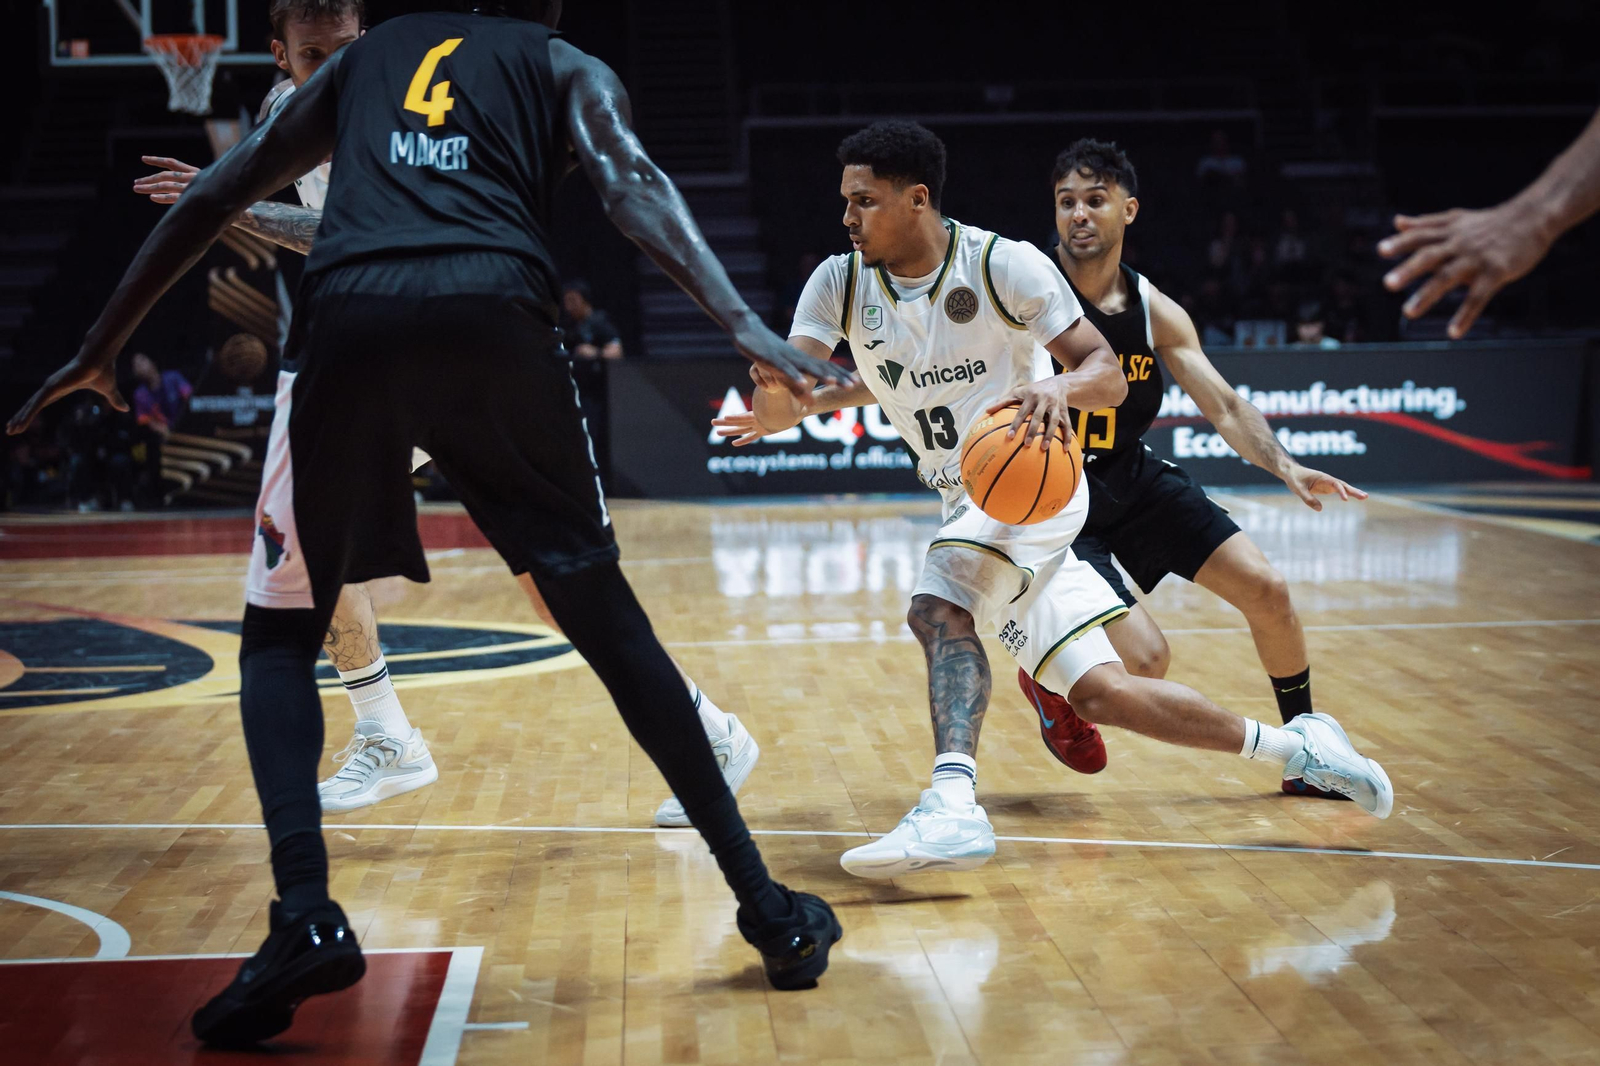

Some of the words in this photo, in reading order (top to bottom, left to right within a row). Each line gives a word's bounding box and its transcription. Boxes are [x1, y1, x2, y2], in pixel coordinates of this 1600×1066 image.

[403, 37, 464, 127] 4
[390, 131, 469, 170] MAKER
[1128, 355, 1153, 382] SC
[1235, 380, 1467, 420] anufacturing.
[913, 405, 959, 450] 13
[1173, 426, 1367, 465] Ecotems.
[707, 450, 829, 477] ecosystems
[830, 445, 854, 471] of
[1008, 629, 1023, 645] SOL
